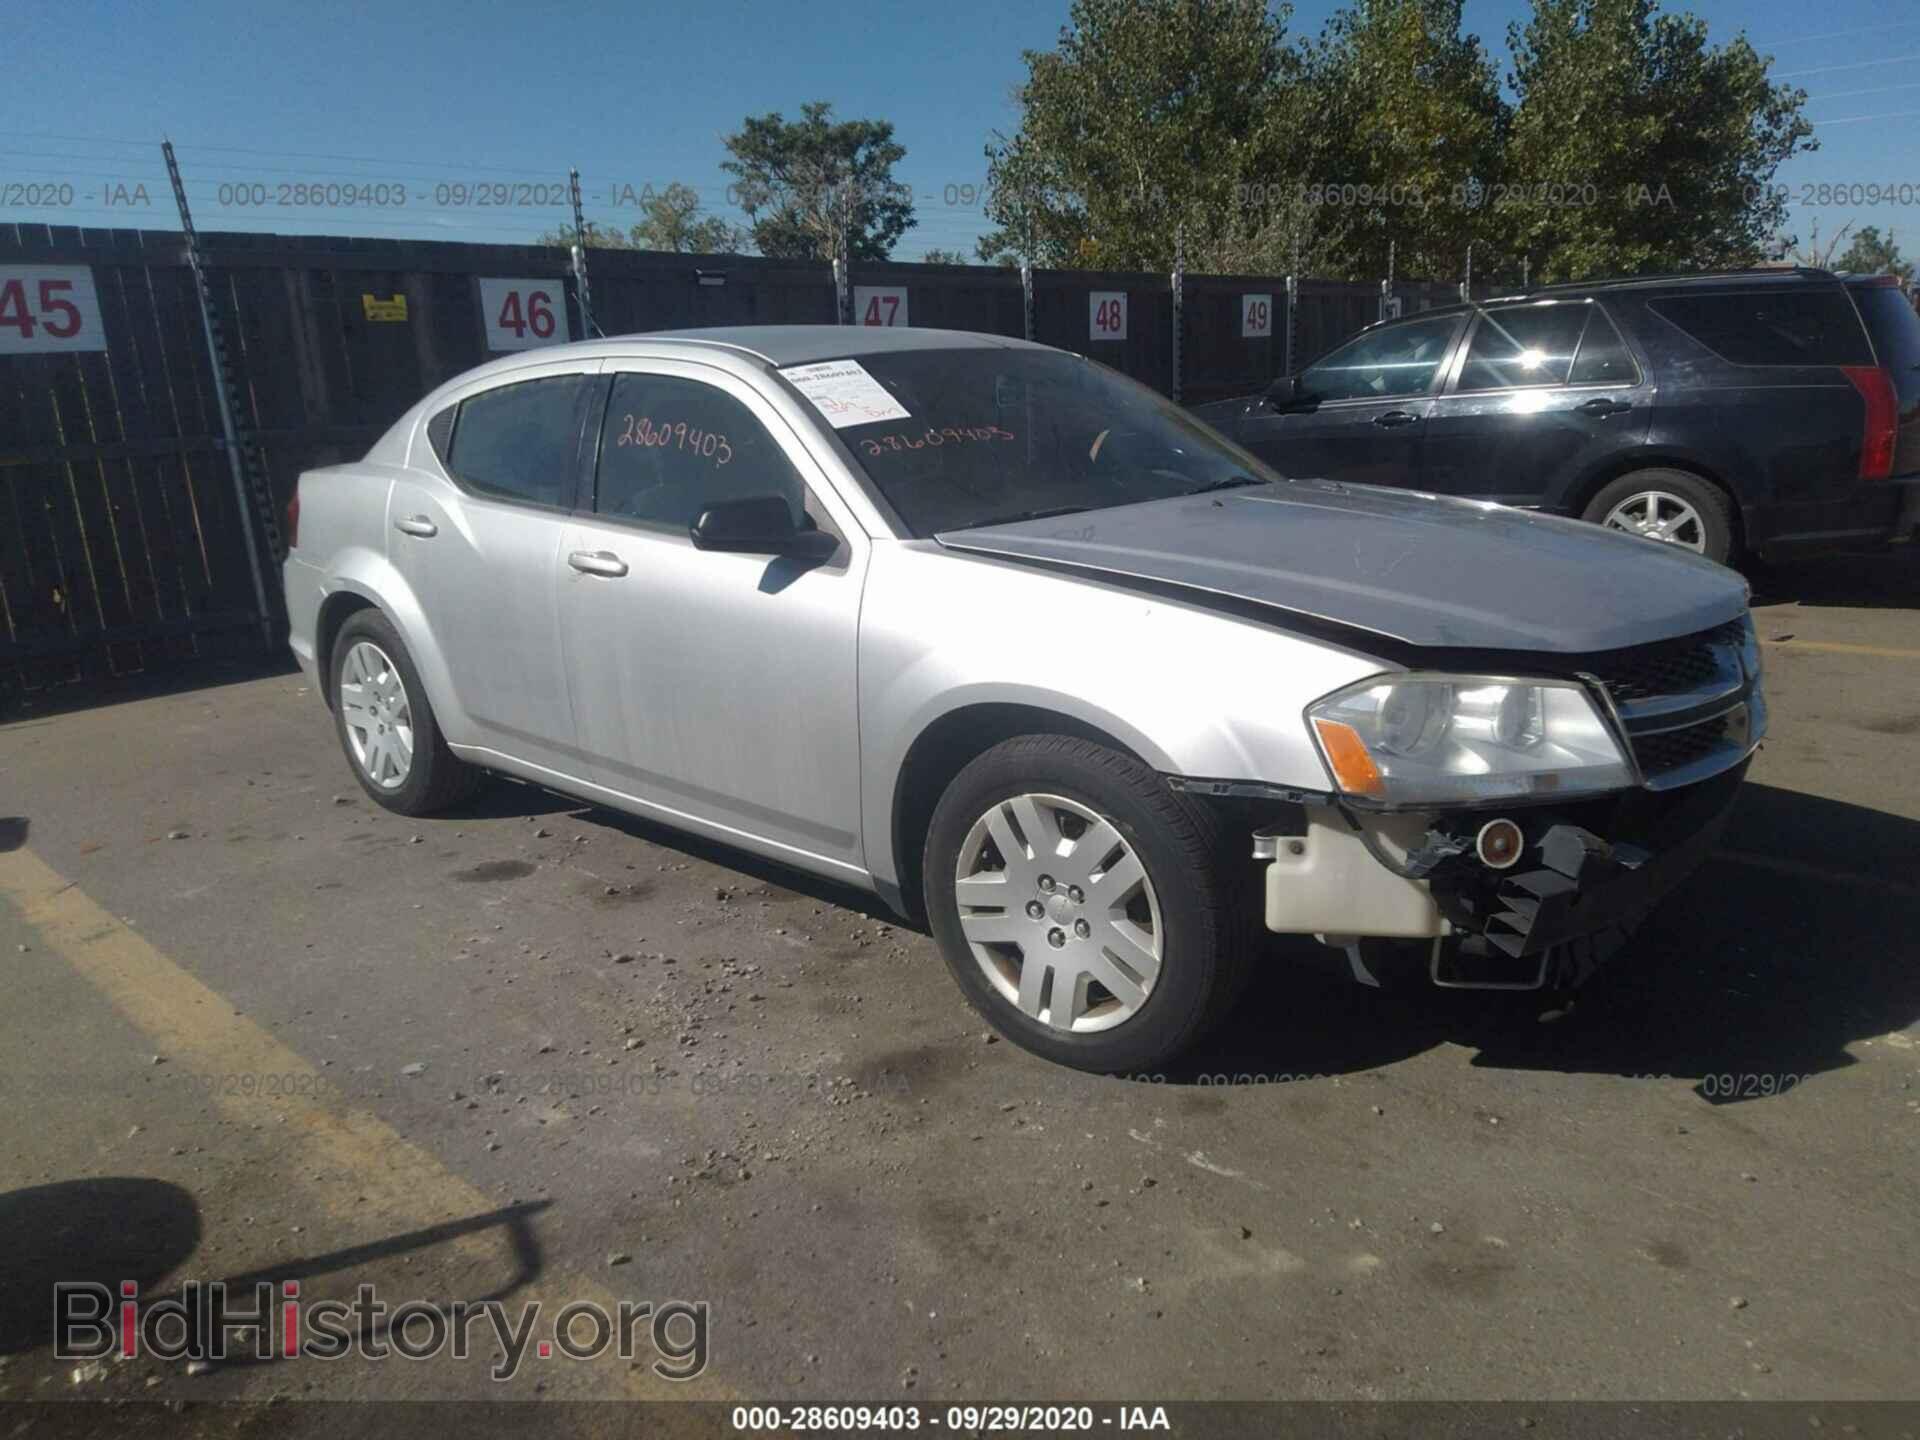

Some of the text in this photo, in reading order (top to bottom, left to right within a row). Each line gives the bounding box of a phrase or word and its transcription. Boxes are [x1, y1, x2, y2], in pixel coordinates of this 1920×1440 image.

[0, 280, 82, 338] 45
[500, 290, 556, 339] 46
[863, 295, 900, 327] 47
[1096, 300, 1120, 332] 48
[1248, 302, 1267, 330] 49
[617, 414, 732, 464] 28609403
